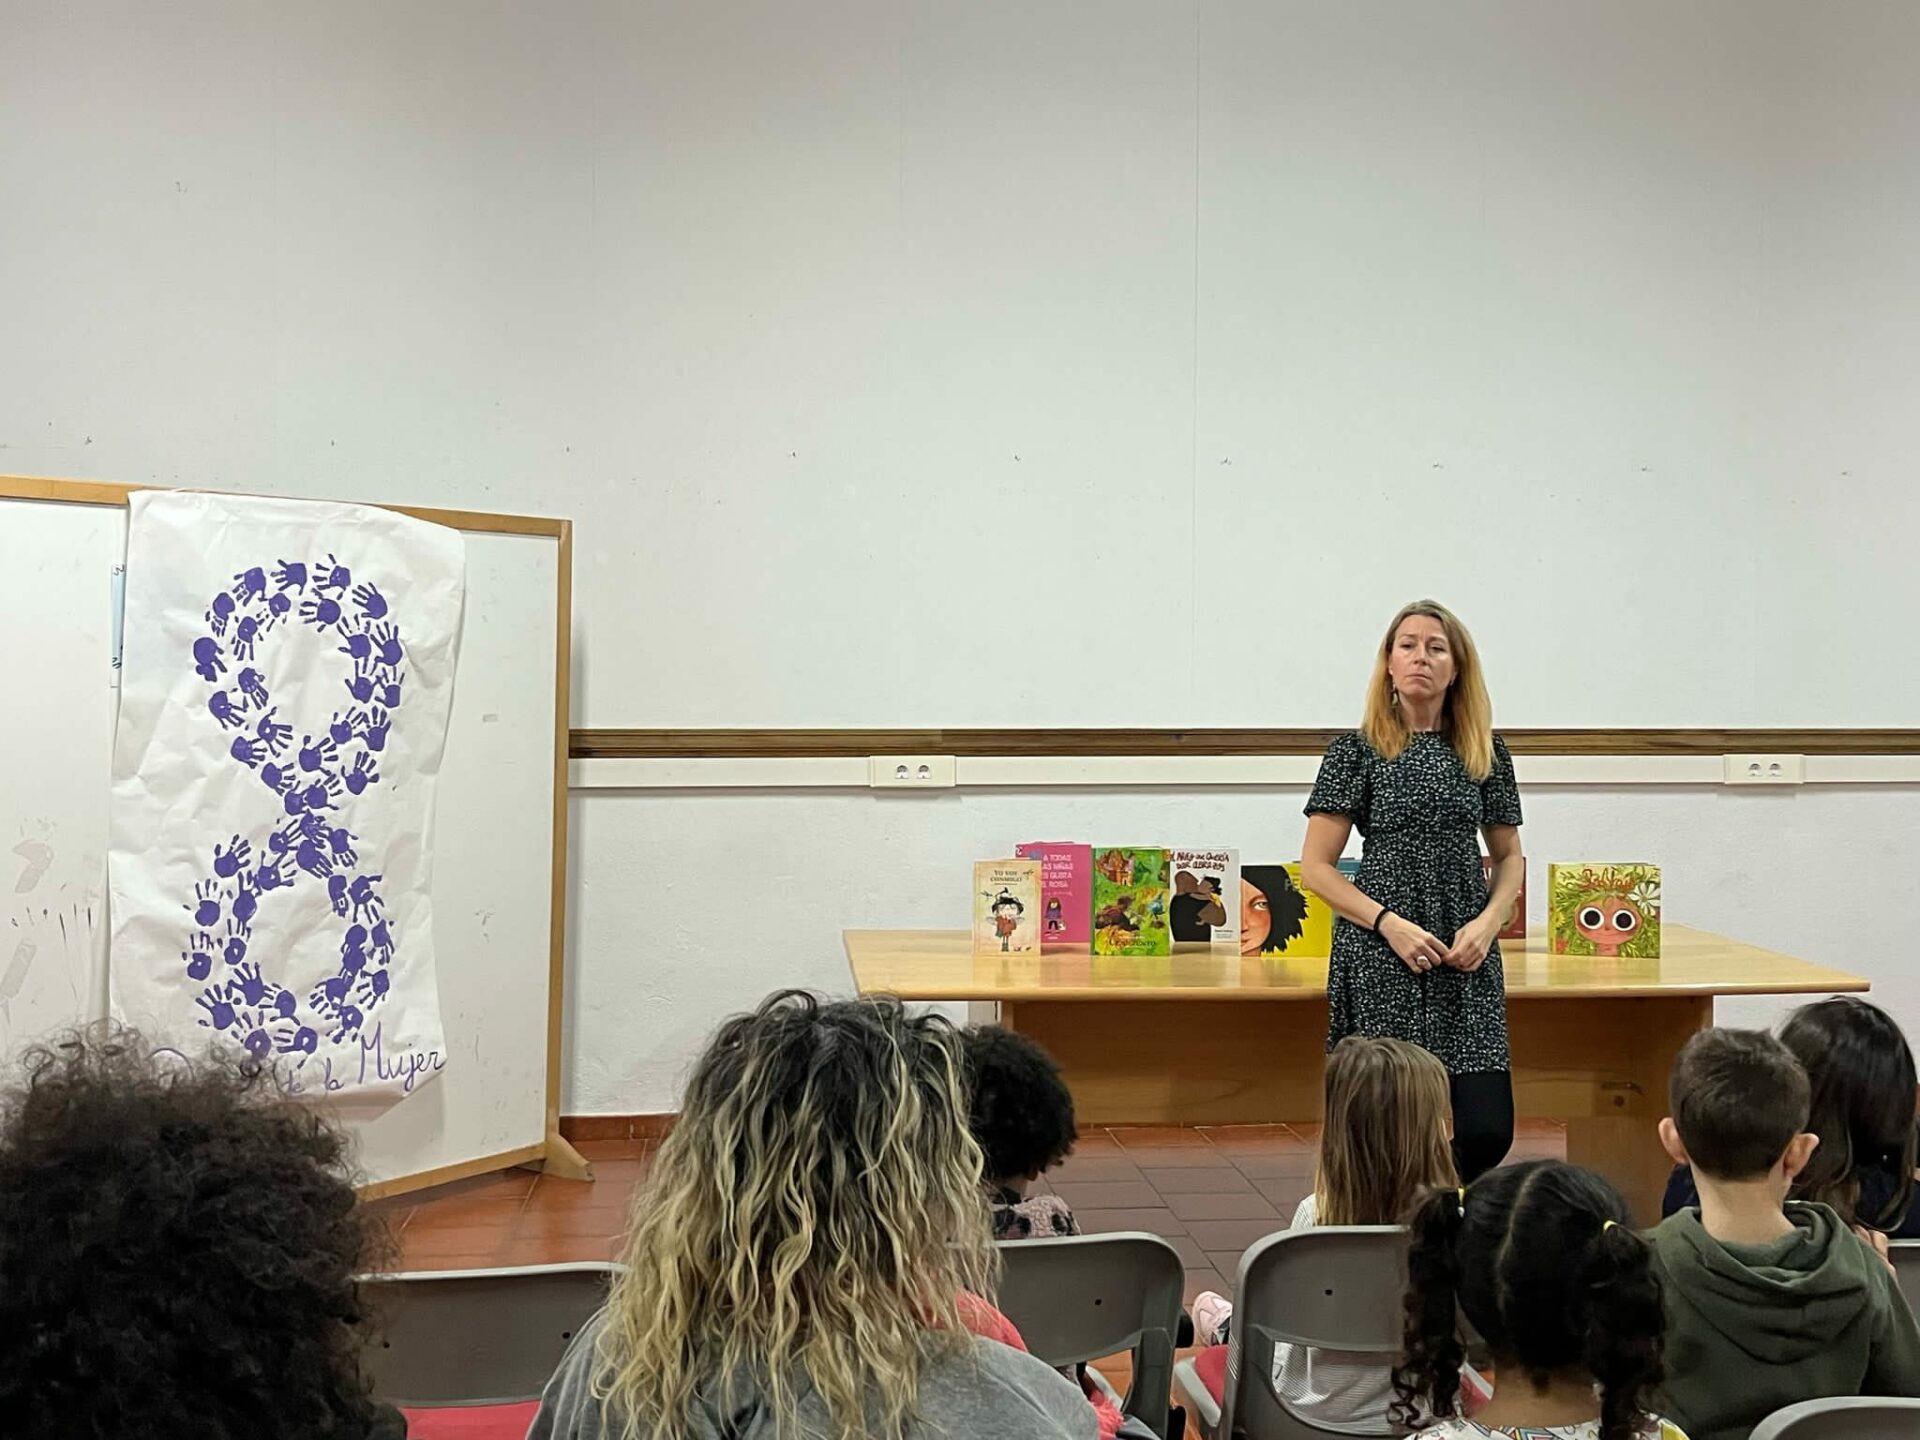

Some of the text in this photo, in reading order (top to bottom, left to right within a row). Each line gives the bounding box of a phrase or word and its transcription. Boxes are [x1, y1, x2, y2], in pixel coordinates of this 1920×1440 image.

[1050, 854, 1072, 862] TODAS
[994, 869, 1004, 877] YO
[1050, 872, 1073, 880] GUSTA
[1049, 880, 1069, 889] ROSA
[323, 1057, 344, 1091] la
[358, 1021, 448, 1091] Mujer
